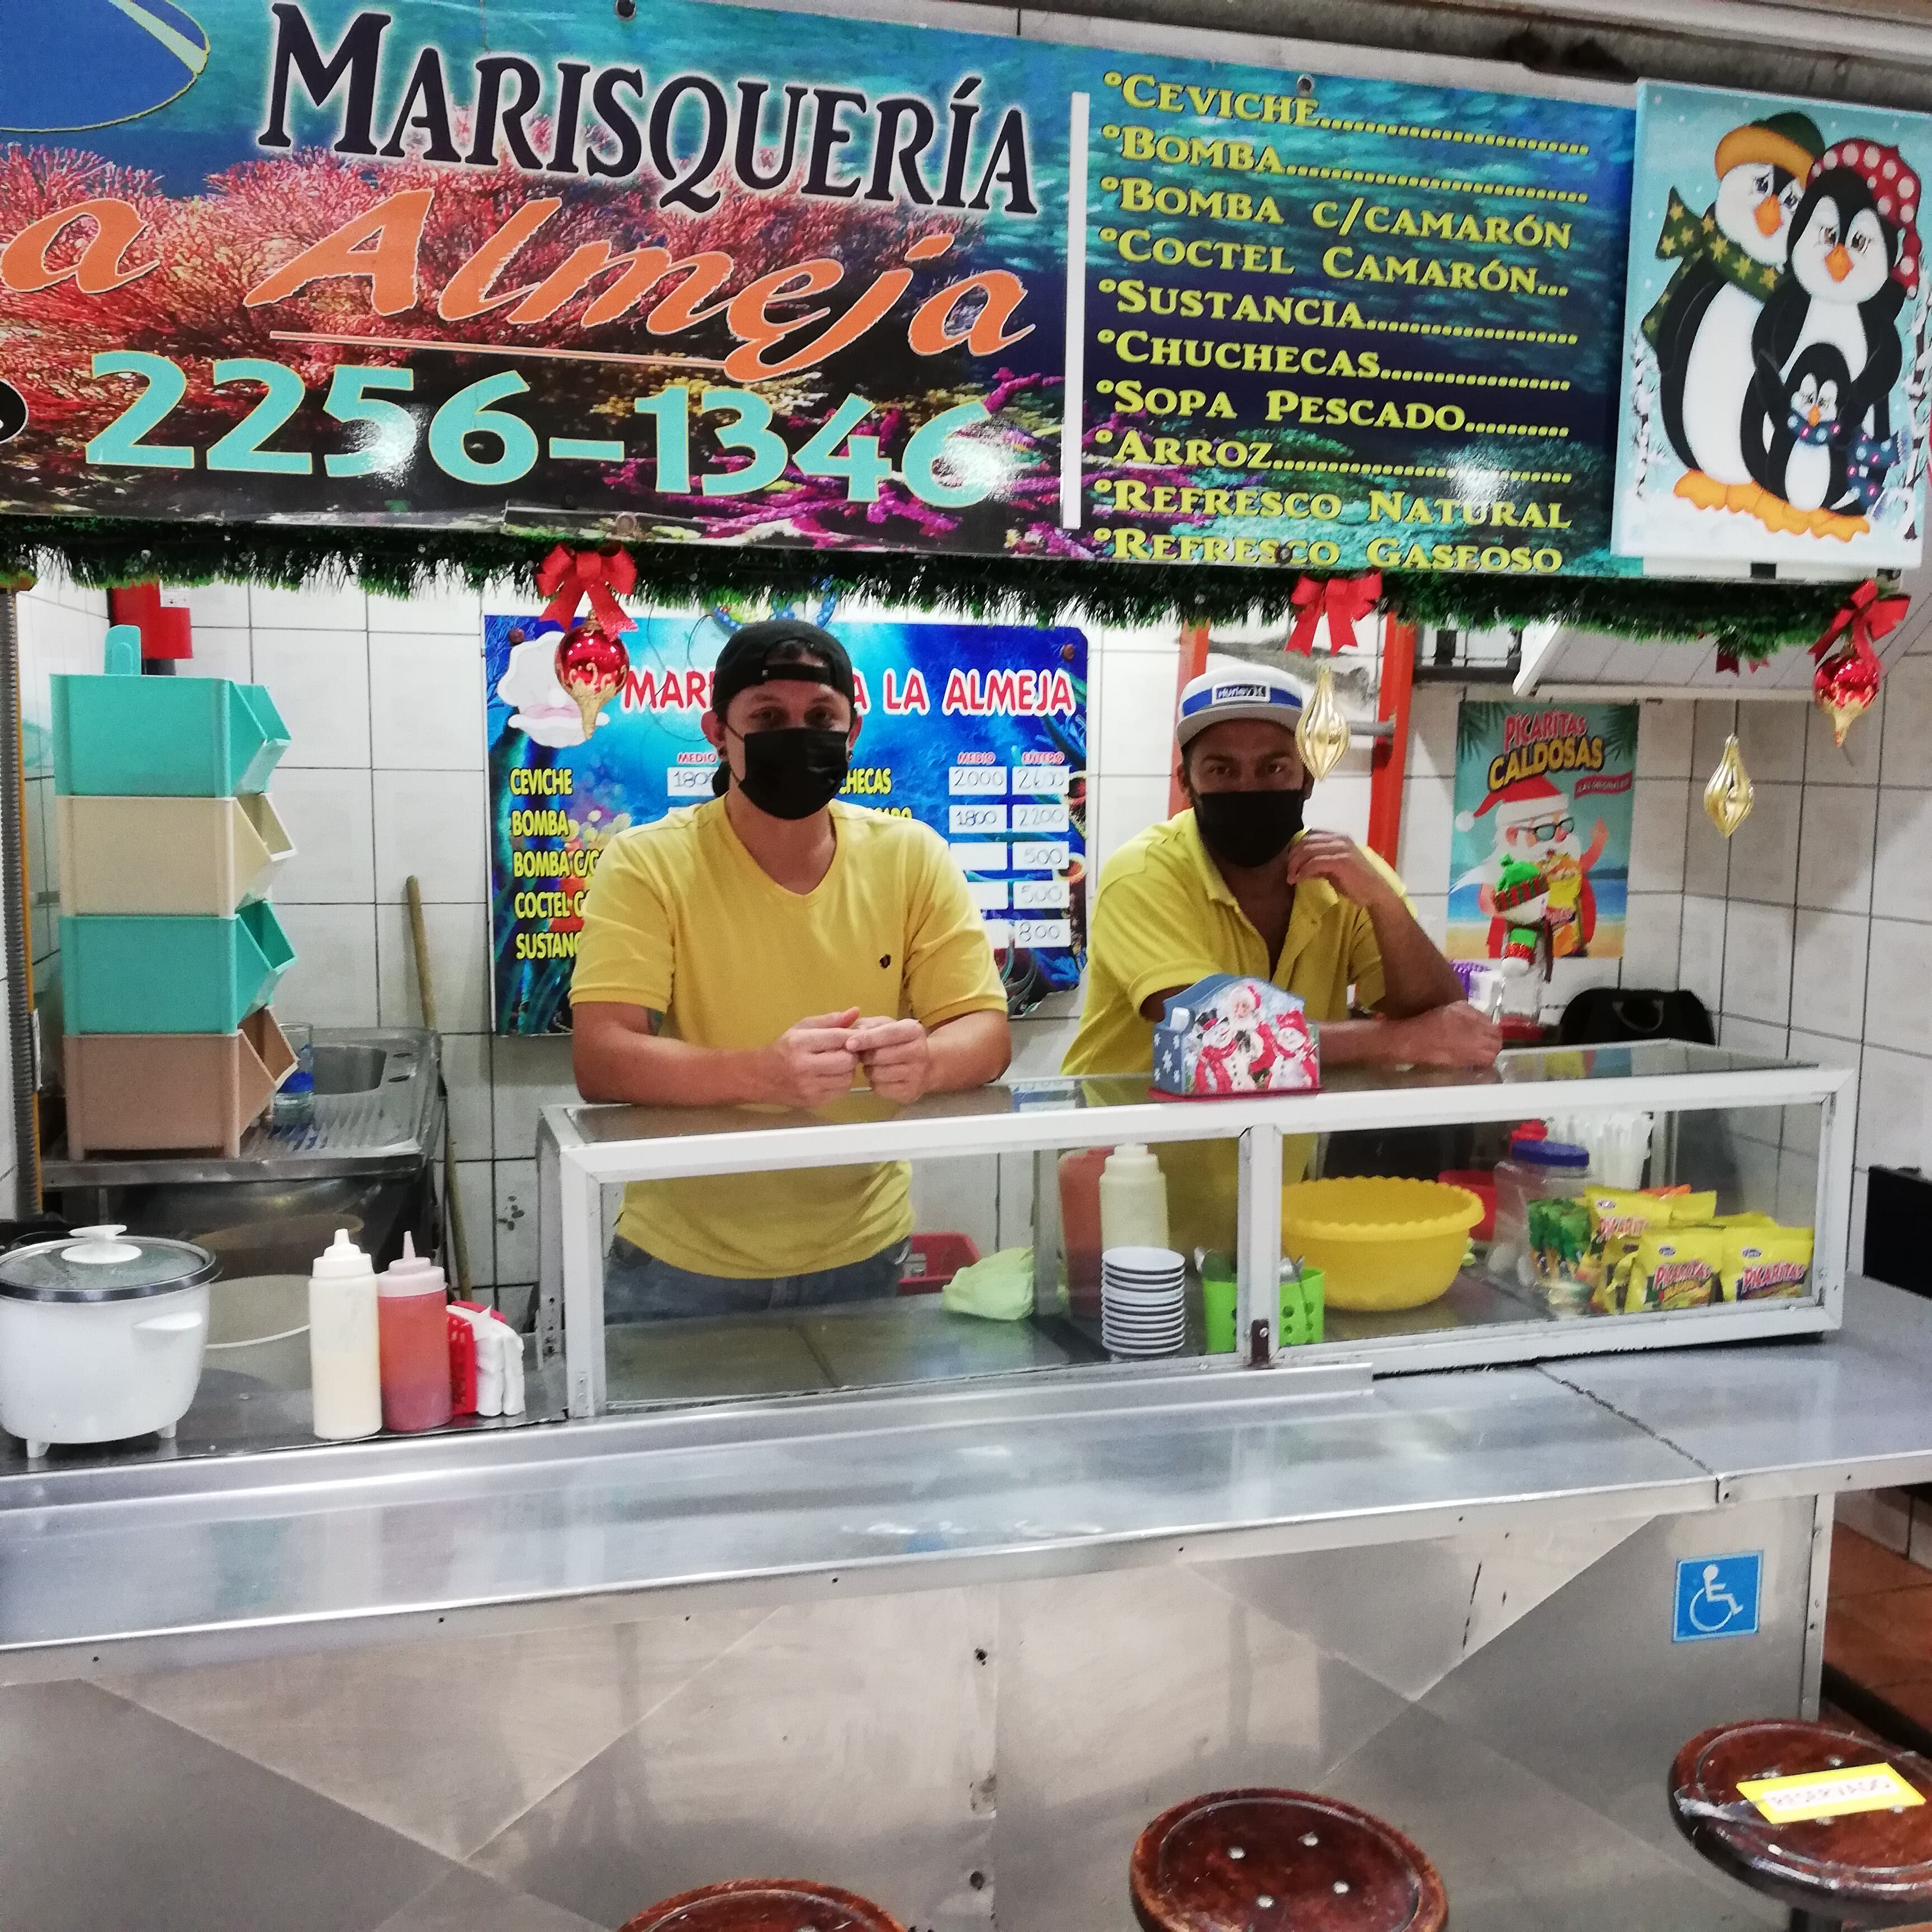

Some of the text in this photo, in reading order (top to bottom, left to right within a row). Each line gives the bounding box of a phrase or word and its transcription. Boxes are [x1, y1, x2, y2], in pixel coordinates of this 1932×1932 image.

[258, 3, 1038, 214] MARISQUERÍA
[243, 189, 1036, 383] Almeja
[85, 350, 1003, 509] 2256-1346
[886, 673, 927, 711] LA
[945, 671, 1074, 712] ALMEJA
[1504, 708, 1588, 752] PICARITAS
[678, 753, 716, 764] MEDIO
[1488, 736, 1605, 793] CALDOSAS
[510, 768, 572, 796] CEVICHE
[673, 771, 716, 788] 180
[954, 769, 1005, 787] 2000
[511, 809, 570, 837] BOMBA
[956, 809, 997, 827] 1800
[1019, 808, 1065, 827] 2200
[513, 850, 570, 878] BOMBA
[1024, 847, 1062, 865] 500
[514, 891, 570, 920] COCTEL
[1021, 884, 1062, 903] 500
[1019, 921, 1060, 943] 800
